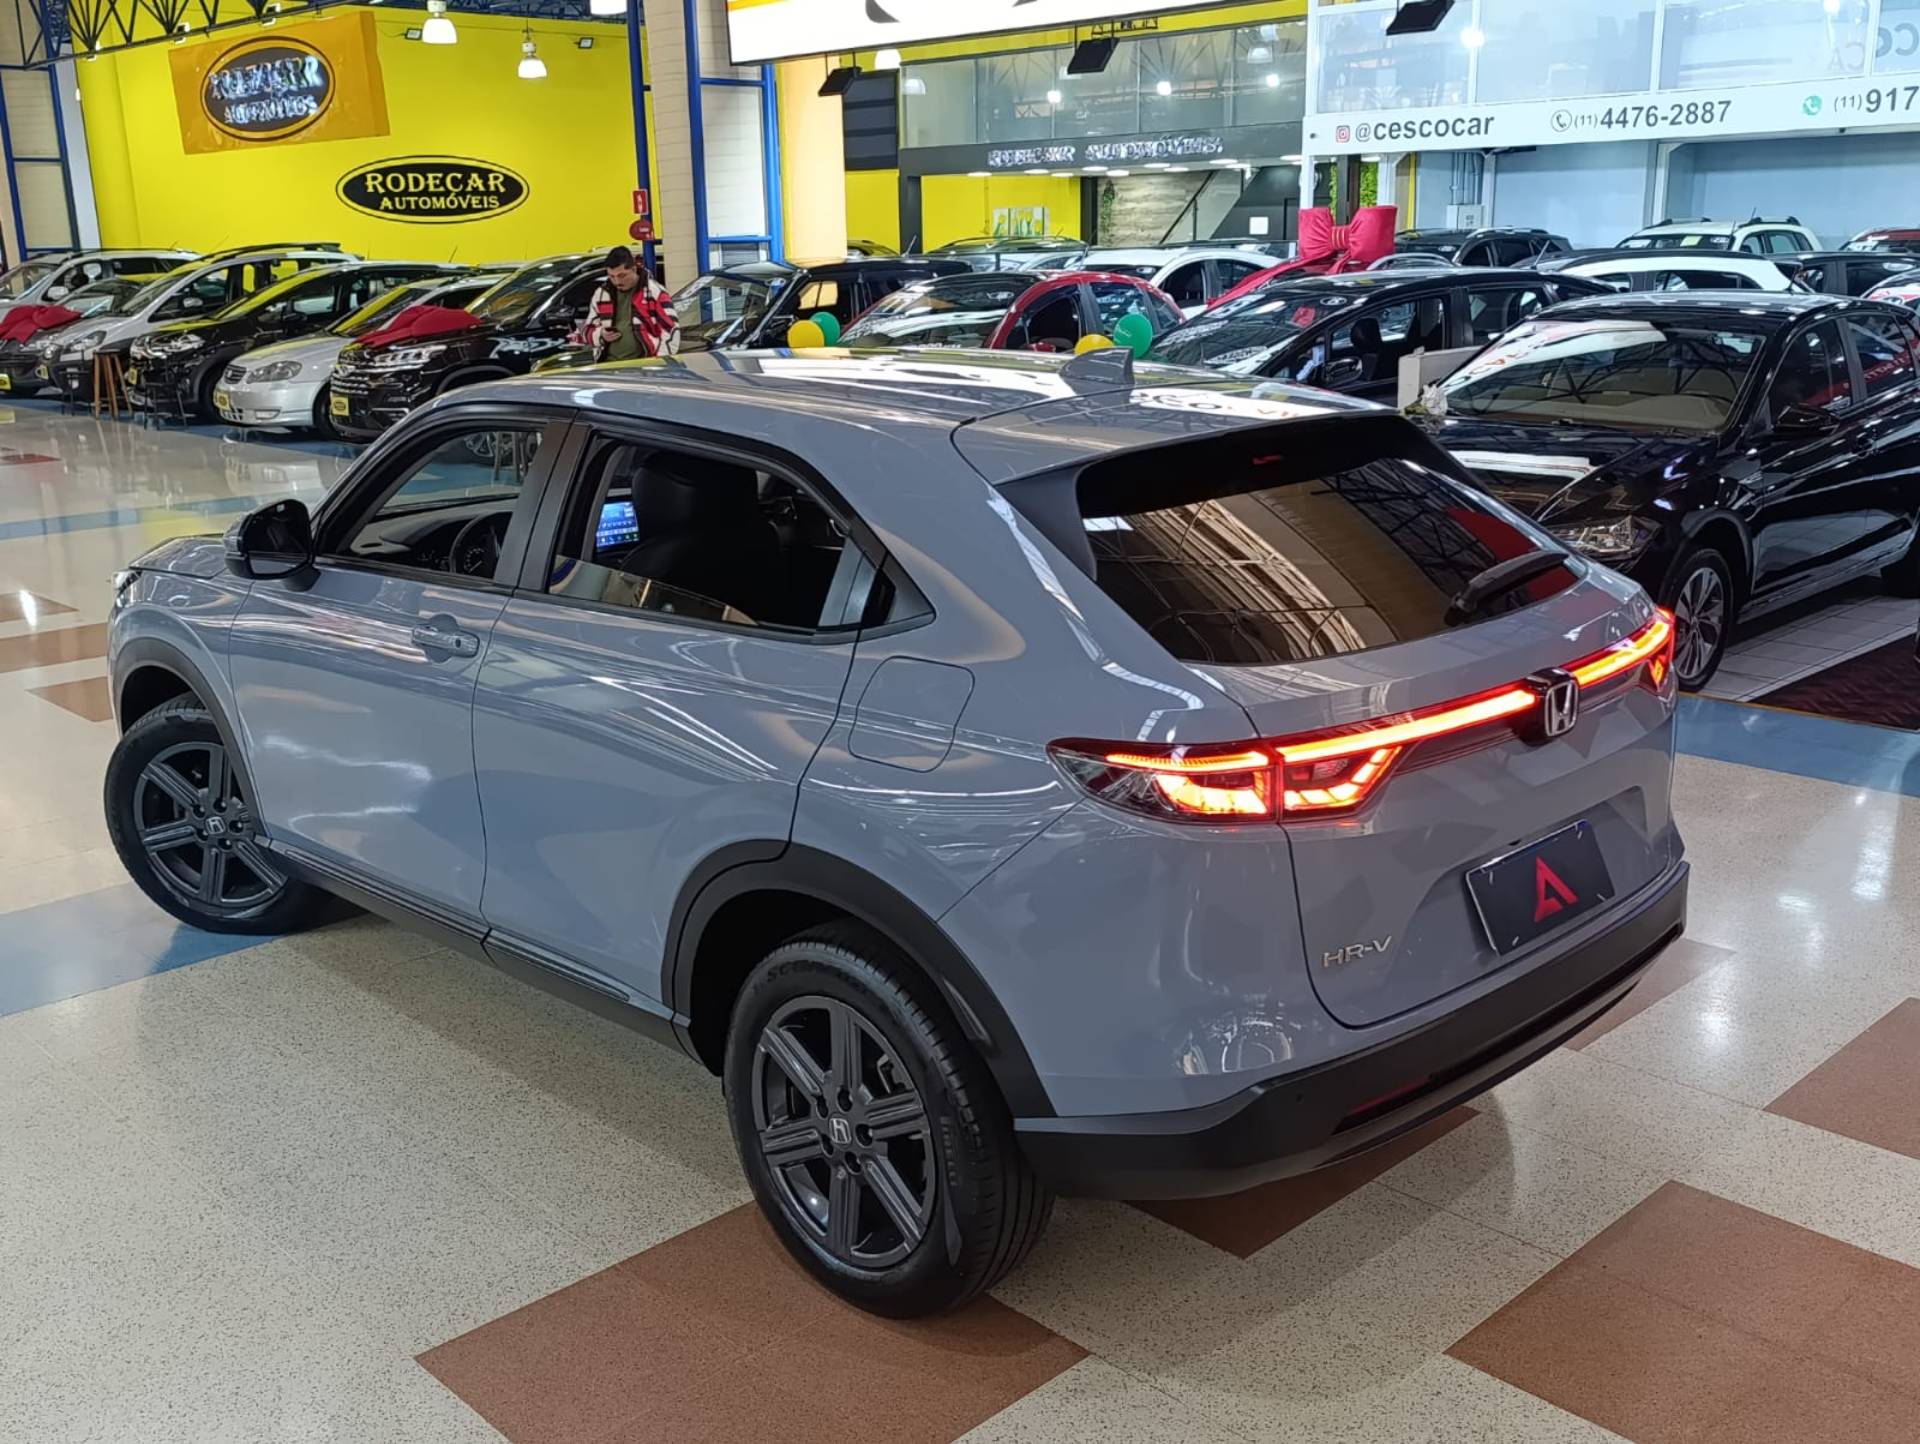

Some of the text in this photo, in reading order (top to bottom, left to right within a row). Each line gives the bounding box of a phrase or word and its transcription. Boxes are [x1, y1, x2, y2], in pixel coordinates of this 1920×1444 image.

[1355, 114, 1496, 143] @cescocar
[365, 172, 506, 194] RODECAR
[379, 193, 500, 211] AUTOMÓVEIS
[1322, 935, 1392, 967] HR-V
